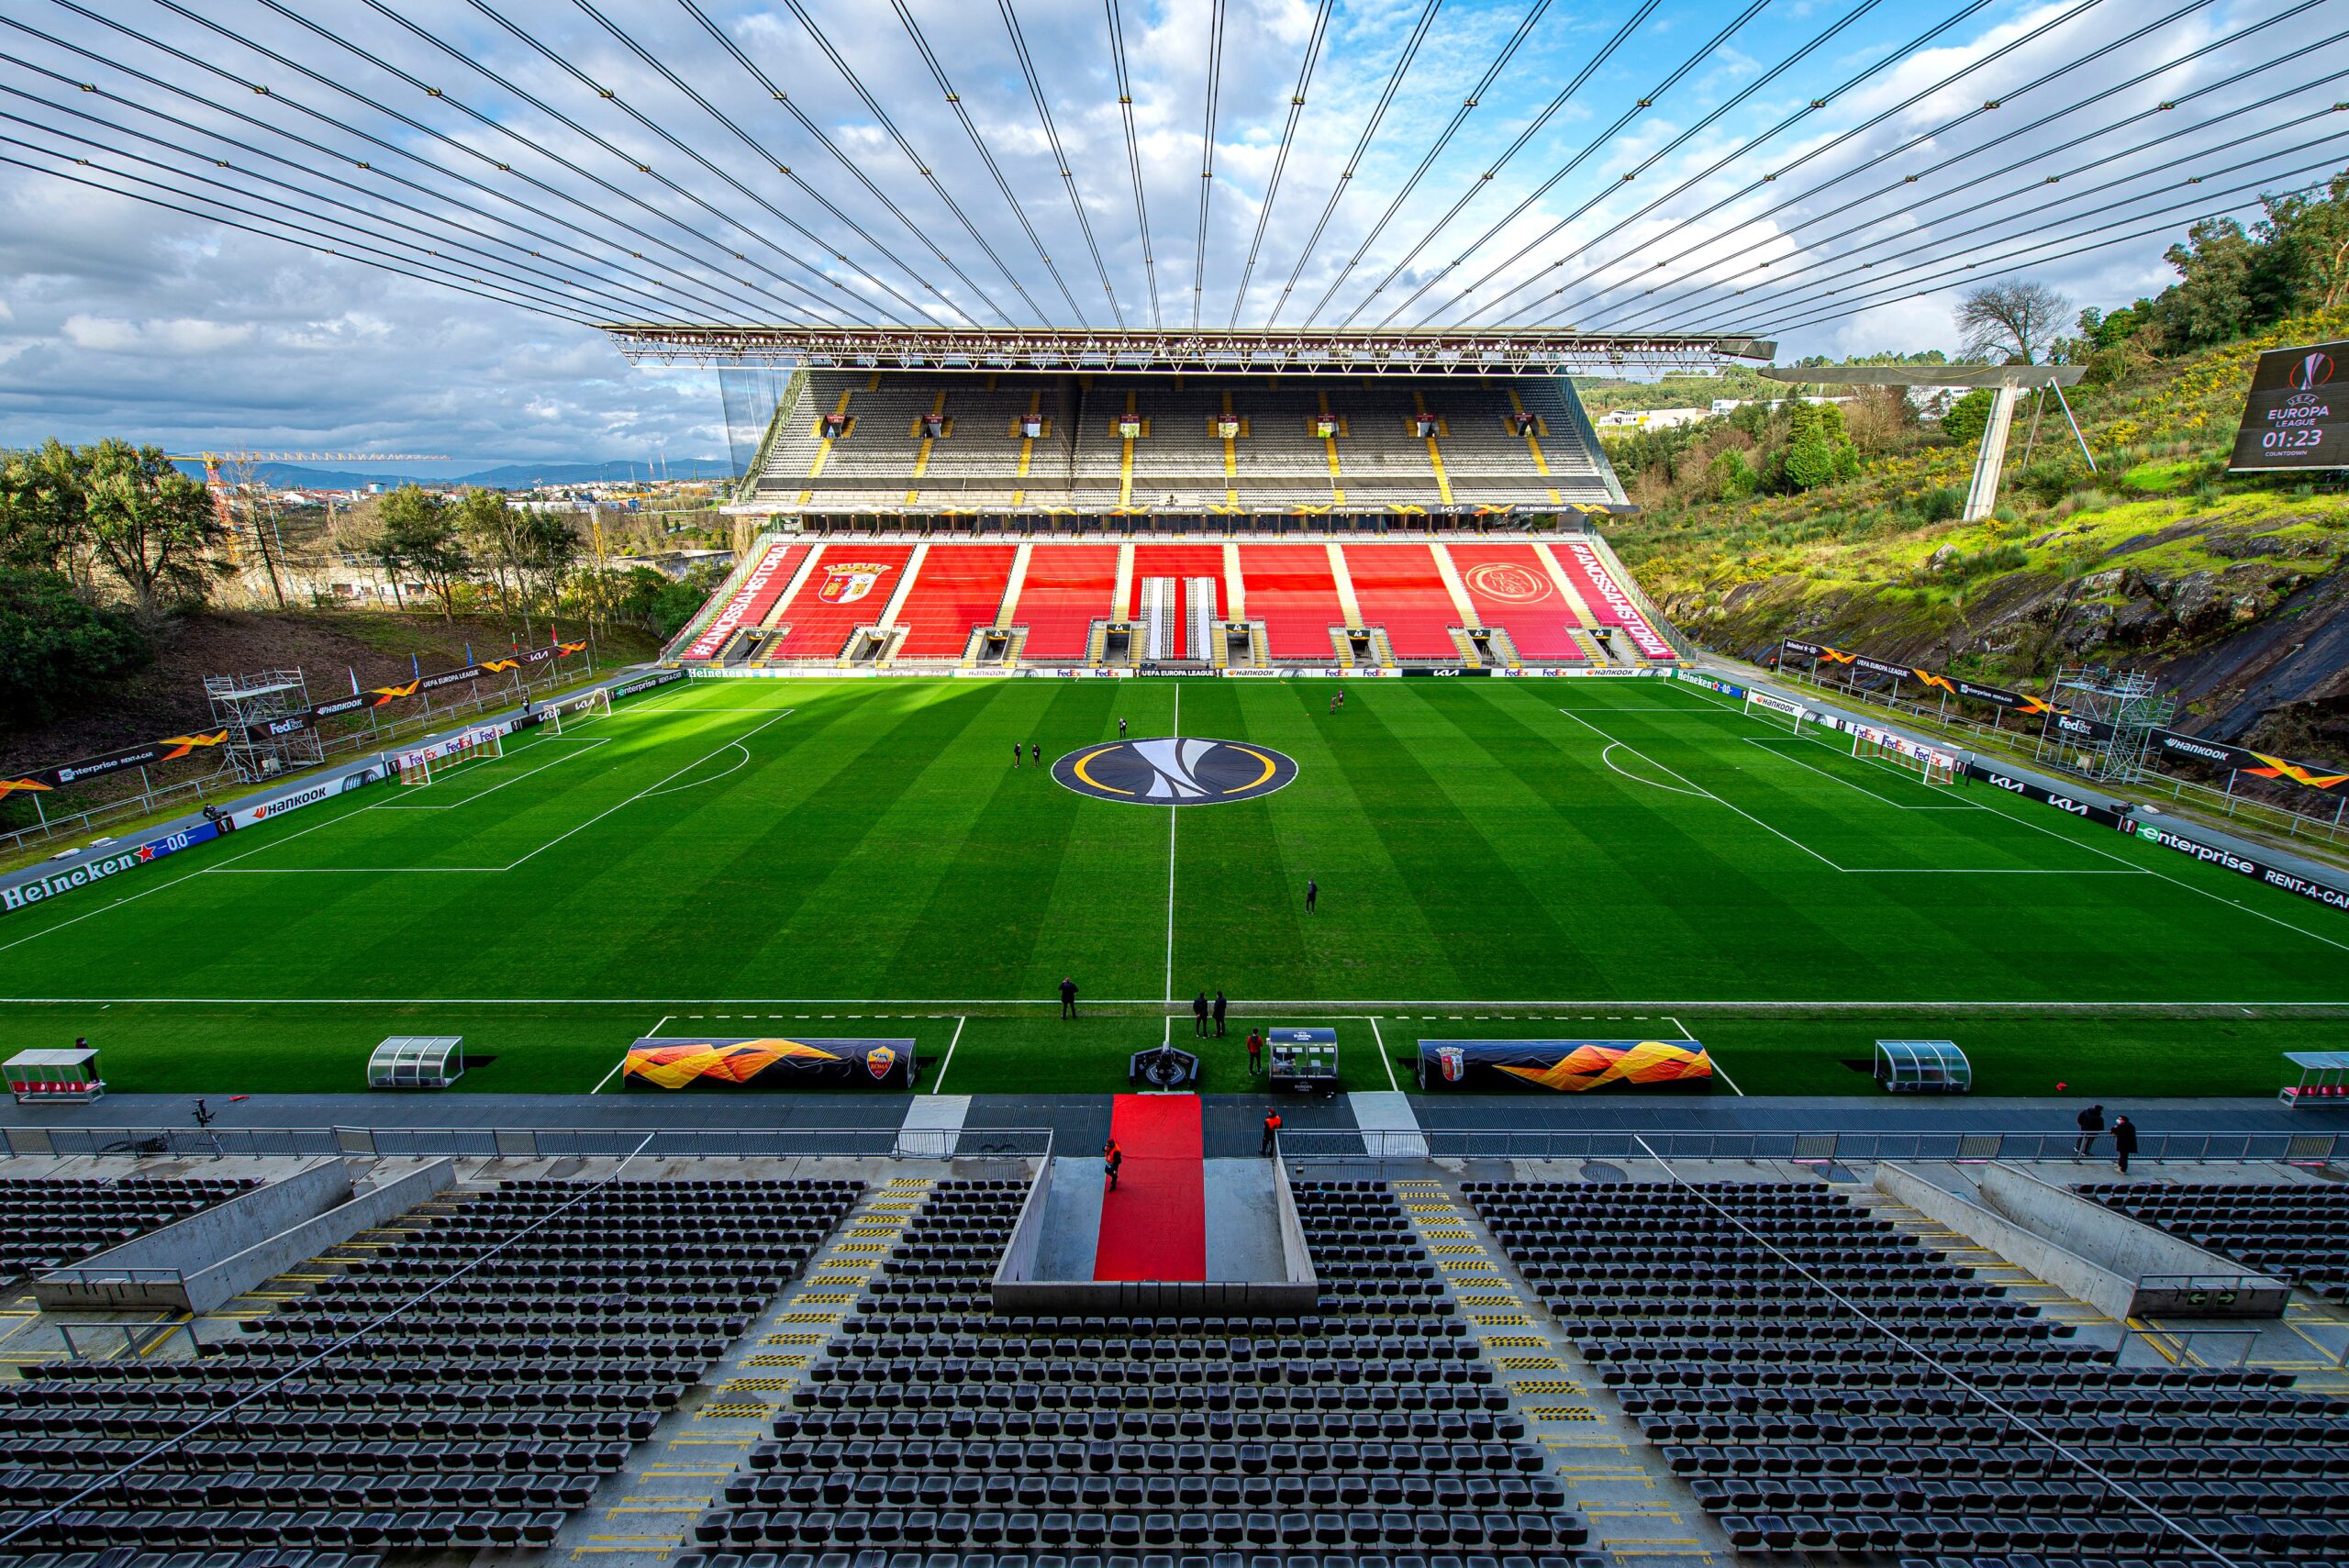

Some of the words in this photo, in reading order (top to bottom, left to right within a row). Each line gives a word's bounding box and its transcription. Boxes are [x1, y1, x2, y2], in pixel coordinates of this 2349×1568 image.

[2267, 406, 2330, 420] EUROPA
[2275, 418, 2316, 428] LEAGUE
[2262, 428, 2323, 449] 01:23
[1057, 669, 1082, 677] FedEx
[1095, 669, 1119, 677] FedEx
[1325, 669, 1350, 677] FedEx
[1363, 669, 1387, 677] FedEx
[1504, 669, 1529, 677] FedEx
[1542, 669, 1566, 677] FedEx
[1856, 659, 1869, 668] UEFA
[1870, 662, 1888, 673] EUROPA
[1888, 665, 1909, 677] LEAGUE
[423, 678, 438, 688] UEFA
[438, 674, 459, 686] EUROPA
[459, 669, 480, 682] LEAGUE
[1677, 670, 1712, 689] Heineken
[618, 679, 656, 697] enterprise
[269, 718, 305, 735] FedEx
[2058, 716, 2092, 735] FedEx
[446, 738, 472, 753] FedEx
[1882, 734, 1907, 752] FedEx
[1913, 746, 1942, 766] FedEx
[62, 759, 118, 781] enterprise
[120, 751, 154, 764] RENT-A-CAR
[2142, 825, 2254, 873] enterprise
[0, 853, 136, 912] Heineken
